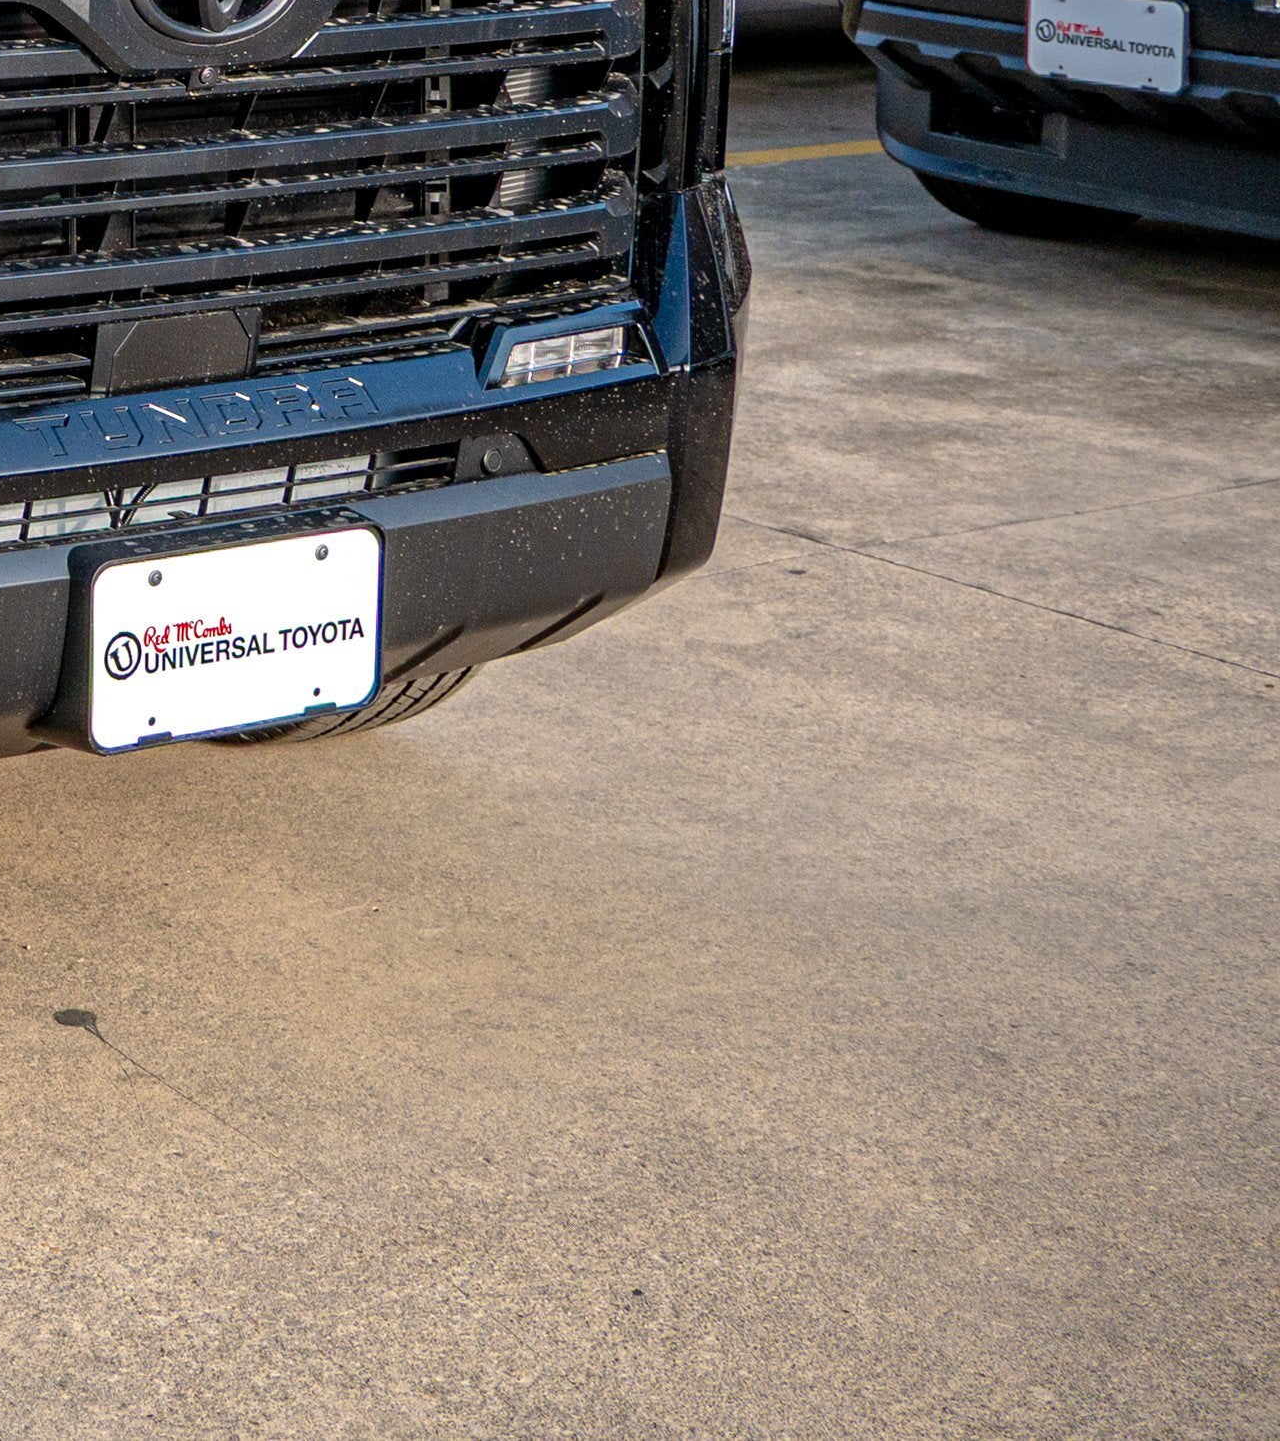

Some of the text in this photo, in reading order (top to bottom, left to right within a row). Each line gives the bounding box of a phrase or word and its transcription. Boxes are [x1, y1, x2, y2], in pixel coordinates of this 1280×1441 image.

[1056, 32, 1176, 59] UNIVERSAL TOYOTA
[11, 377, 381, 458] TUNDRA
[143, 616, 233, 654] Red McCombs
[144, 617, 365, 675] UNIVERSAL TOYOTA
